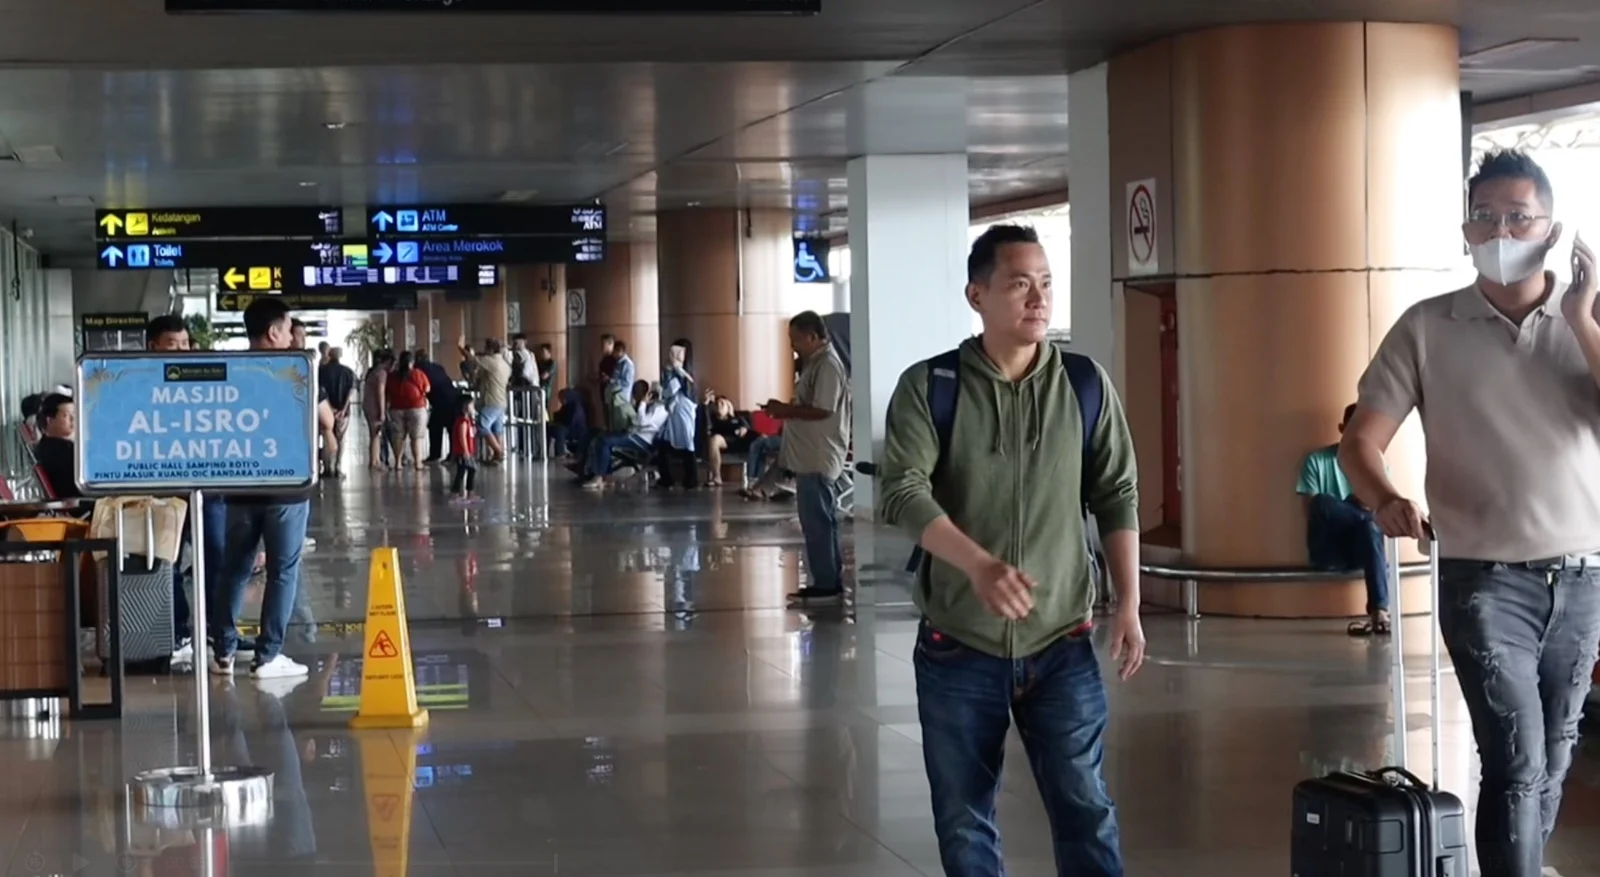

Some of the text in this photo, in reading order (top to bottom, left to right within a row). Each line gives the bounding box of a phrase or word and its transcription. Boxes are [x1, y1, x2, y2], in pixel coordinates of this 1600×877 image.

[421, 209, 446, 222] ATM
[153, 244, 182, 257] Toilet
[423, 239, 504, 252] Area Merokok
[85, 316, 145, 326] Map Direction
[151, 385, 240, 404] MASJID
[128, 408, 270, 434] AL-ISRO'
[116, 438, 278, 460] DI LANTAI 3
[127, 462, 159, 471] PUBLIC
[161, 462, 183, 470] HALL
[186, 461, 227, 469] SAMPING
[94, 471, 121, 479] PINTU
[123, 470, 155, 479] MASUK
[158, 470, 190, 478] RUANG
[211, 469, 253, 478] BANDARA
[256, 468, 295, 477] SUPADIO
